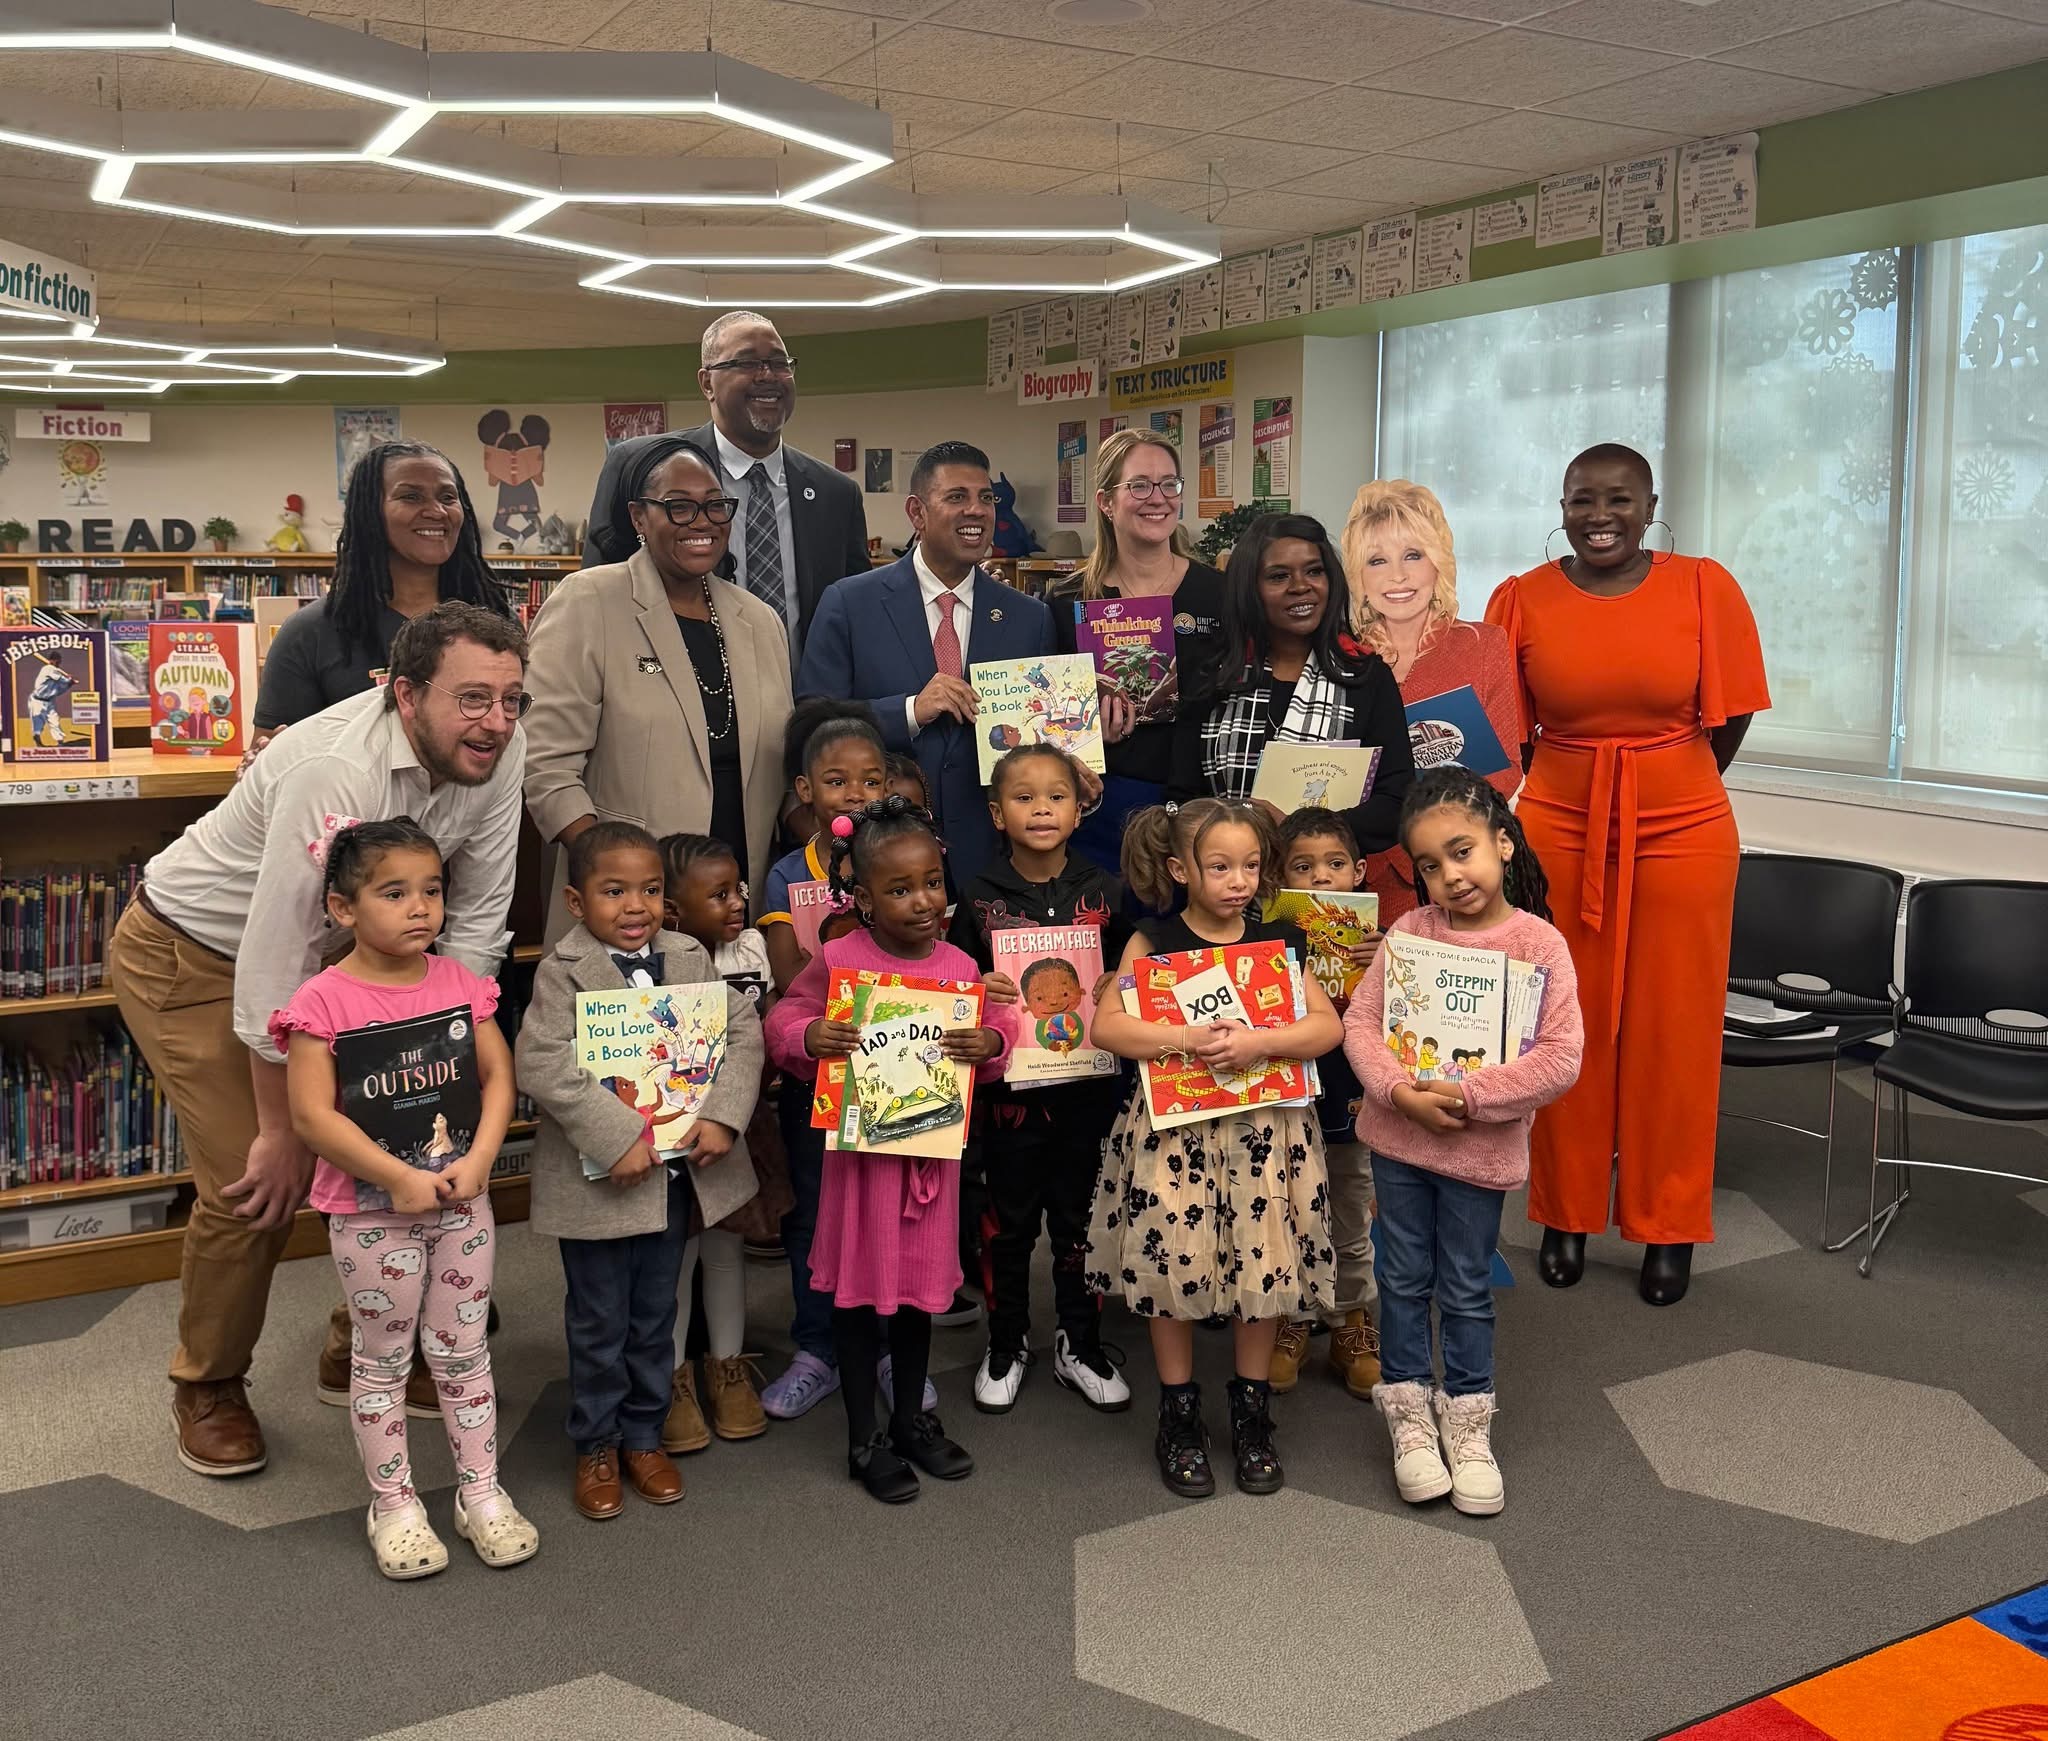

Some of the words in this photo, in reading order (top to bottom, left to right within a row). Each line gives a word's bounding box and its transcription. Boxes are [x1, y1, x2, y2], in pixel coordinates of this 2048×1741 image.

[0, 263, 91, 318] onfiction
[1024, 366, 1093, 401] Biography
[1115, 373, 1146, 396] TEXT
[1150, 359, 1227, 391] STRUCTURE
[43, 415, 123, 437] Fiction
[609, 408, 661, 428] Reading
[1201, 426, 1230, 443] SEQUENCE
[1254, 420, 1290, 439] DESCRIPTIVE
[37, 518, 196, 553] READ
[1090, 616, 1162, 635] Thinking
[177, 644, 209, 652] STEAM
[1103, 634, 1152, 648] Green
[159, 665, 229, 689] AUTUMN
[977, 670, 1008, 682] When
[979, 687, 1000, 698] You
[1004, 684, 1031, 696] Love
[980, 705, 988, 714] a
[992, 702, 1023, 714] Book
[1416, 751, 1458, 769] LIBRARY
[8, 784, 33, 795] 799
[794, 887, 816, 907] ICE
[998, 935, 1018, 954] ICE
[1020, 931, 1066, 952] CREAM
[1067, 930, 1098, 950] FACE
[1405, 947, 1430, 957] OLIVER
[1437, 951, 1460, 961] TOMIE
[586, 1002, 627, 1016] When
[1186, 985, 1233, 1020] BOX
[1445, 990, 1485, 1014] OUT
[586, 1024, 615, 1039] You
[621, 1021, 655, 1035] Love
[861, 1031, 888, 1056] TAD
[891, 1029, 906, 1040] and
[909, 1023, 943, 1041] DAD
[400, 1048, 424, 1065] THE
[586, 1049, 596, 1061] a
[602, 1044, 642, 1060] Book
[1041, 1060, 1069, 1068] Woodward
[363, 1056, 462, 1099] OUTSIDE
[393, 1101, 417, 1111] GIANNA
[418, 1094, 441, 1106] MARINO
[54, 1215, 103, 1239] Lists
